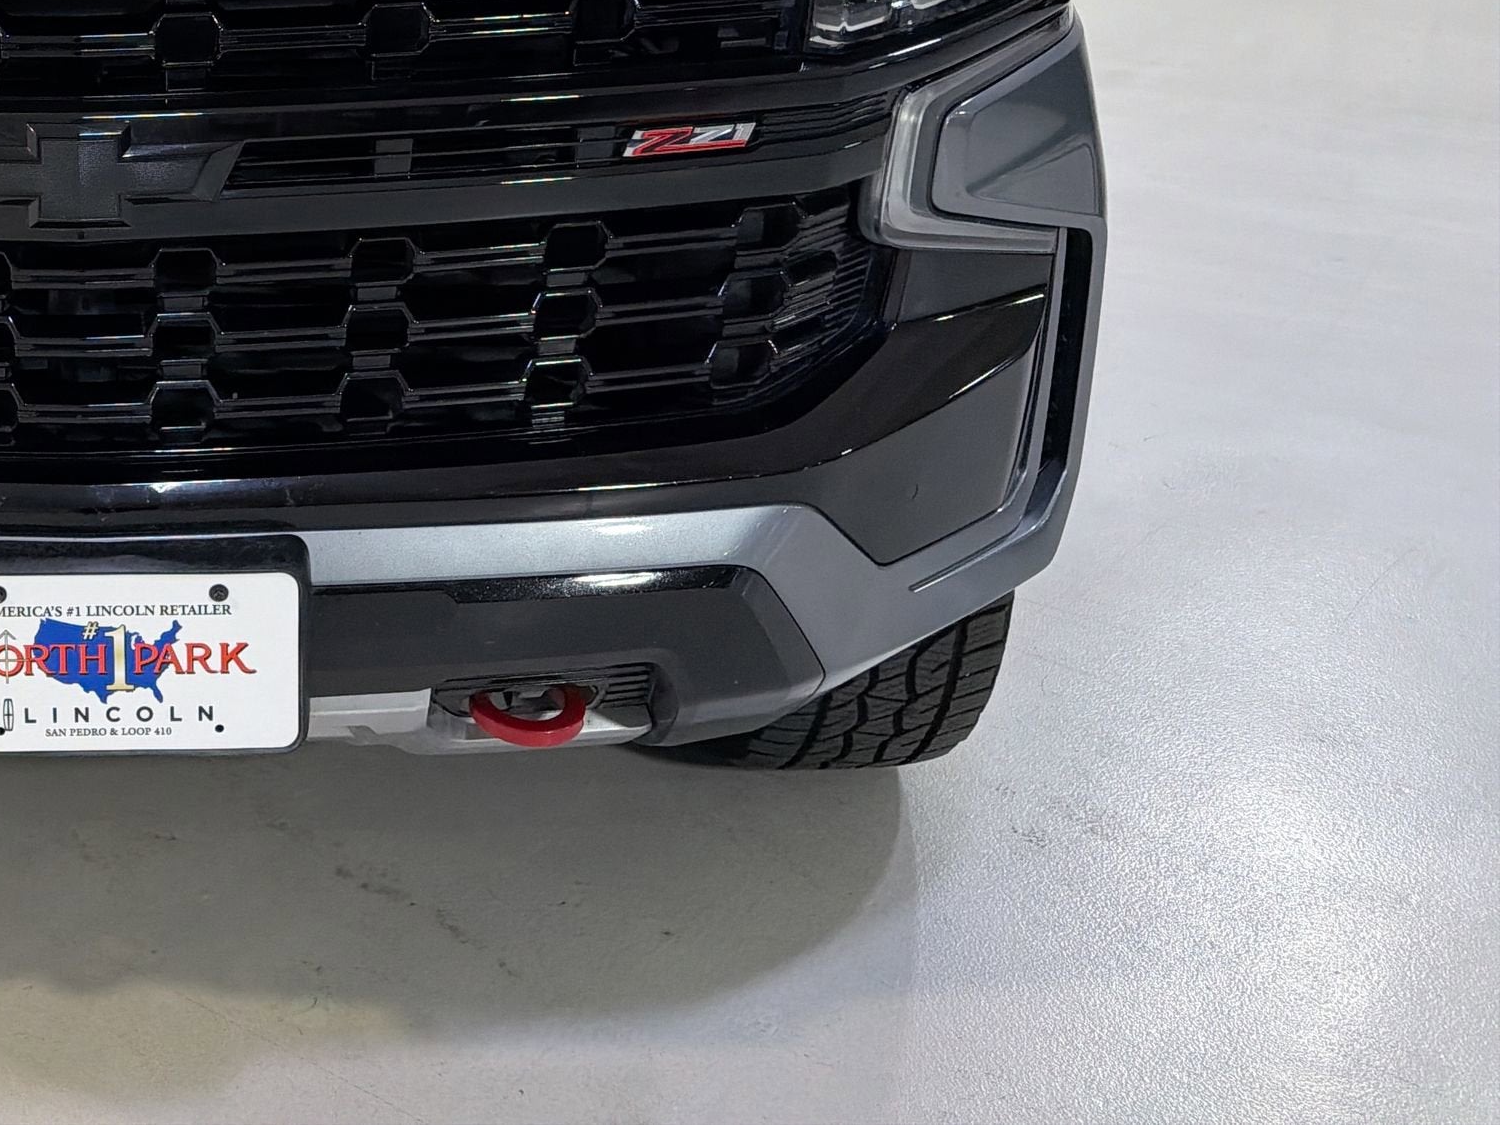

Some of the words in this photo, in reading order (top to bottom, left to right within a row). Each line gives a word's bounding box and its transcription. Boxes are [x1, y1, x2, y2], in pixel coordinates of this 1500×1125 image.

[628, 123, 756, 157] Z71
[66, 605, 82, 617] #1
[86, 604, 156, 617] LINCOLN
[159, 603, 232, 616] RETAILER
[133, 642, 257, 675] PARK
[24, 705, 214, 724] LINCOLN
[45, 728, 67, 737] SAN
[69, 728, 107, 737] PEDRO
[110, 727, 121, 736] &
[121, 727, 151, 736] LOOP
[154, 726, 172, 736] 410
